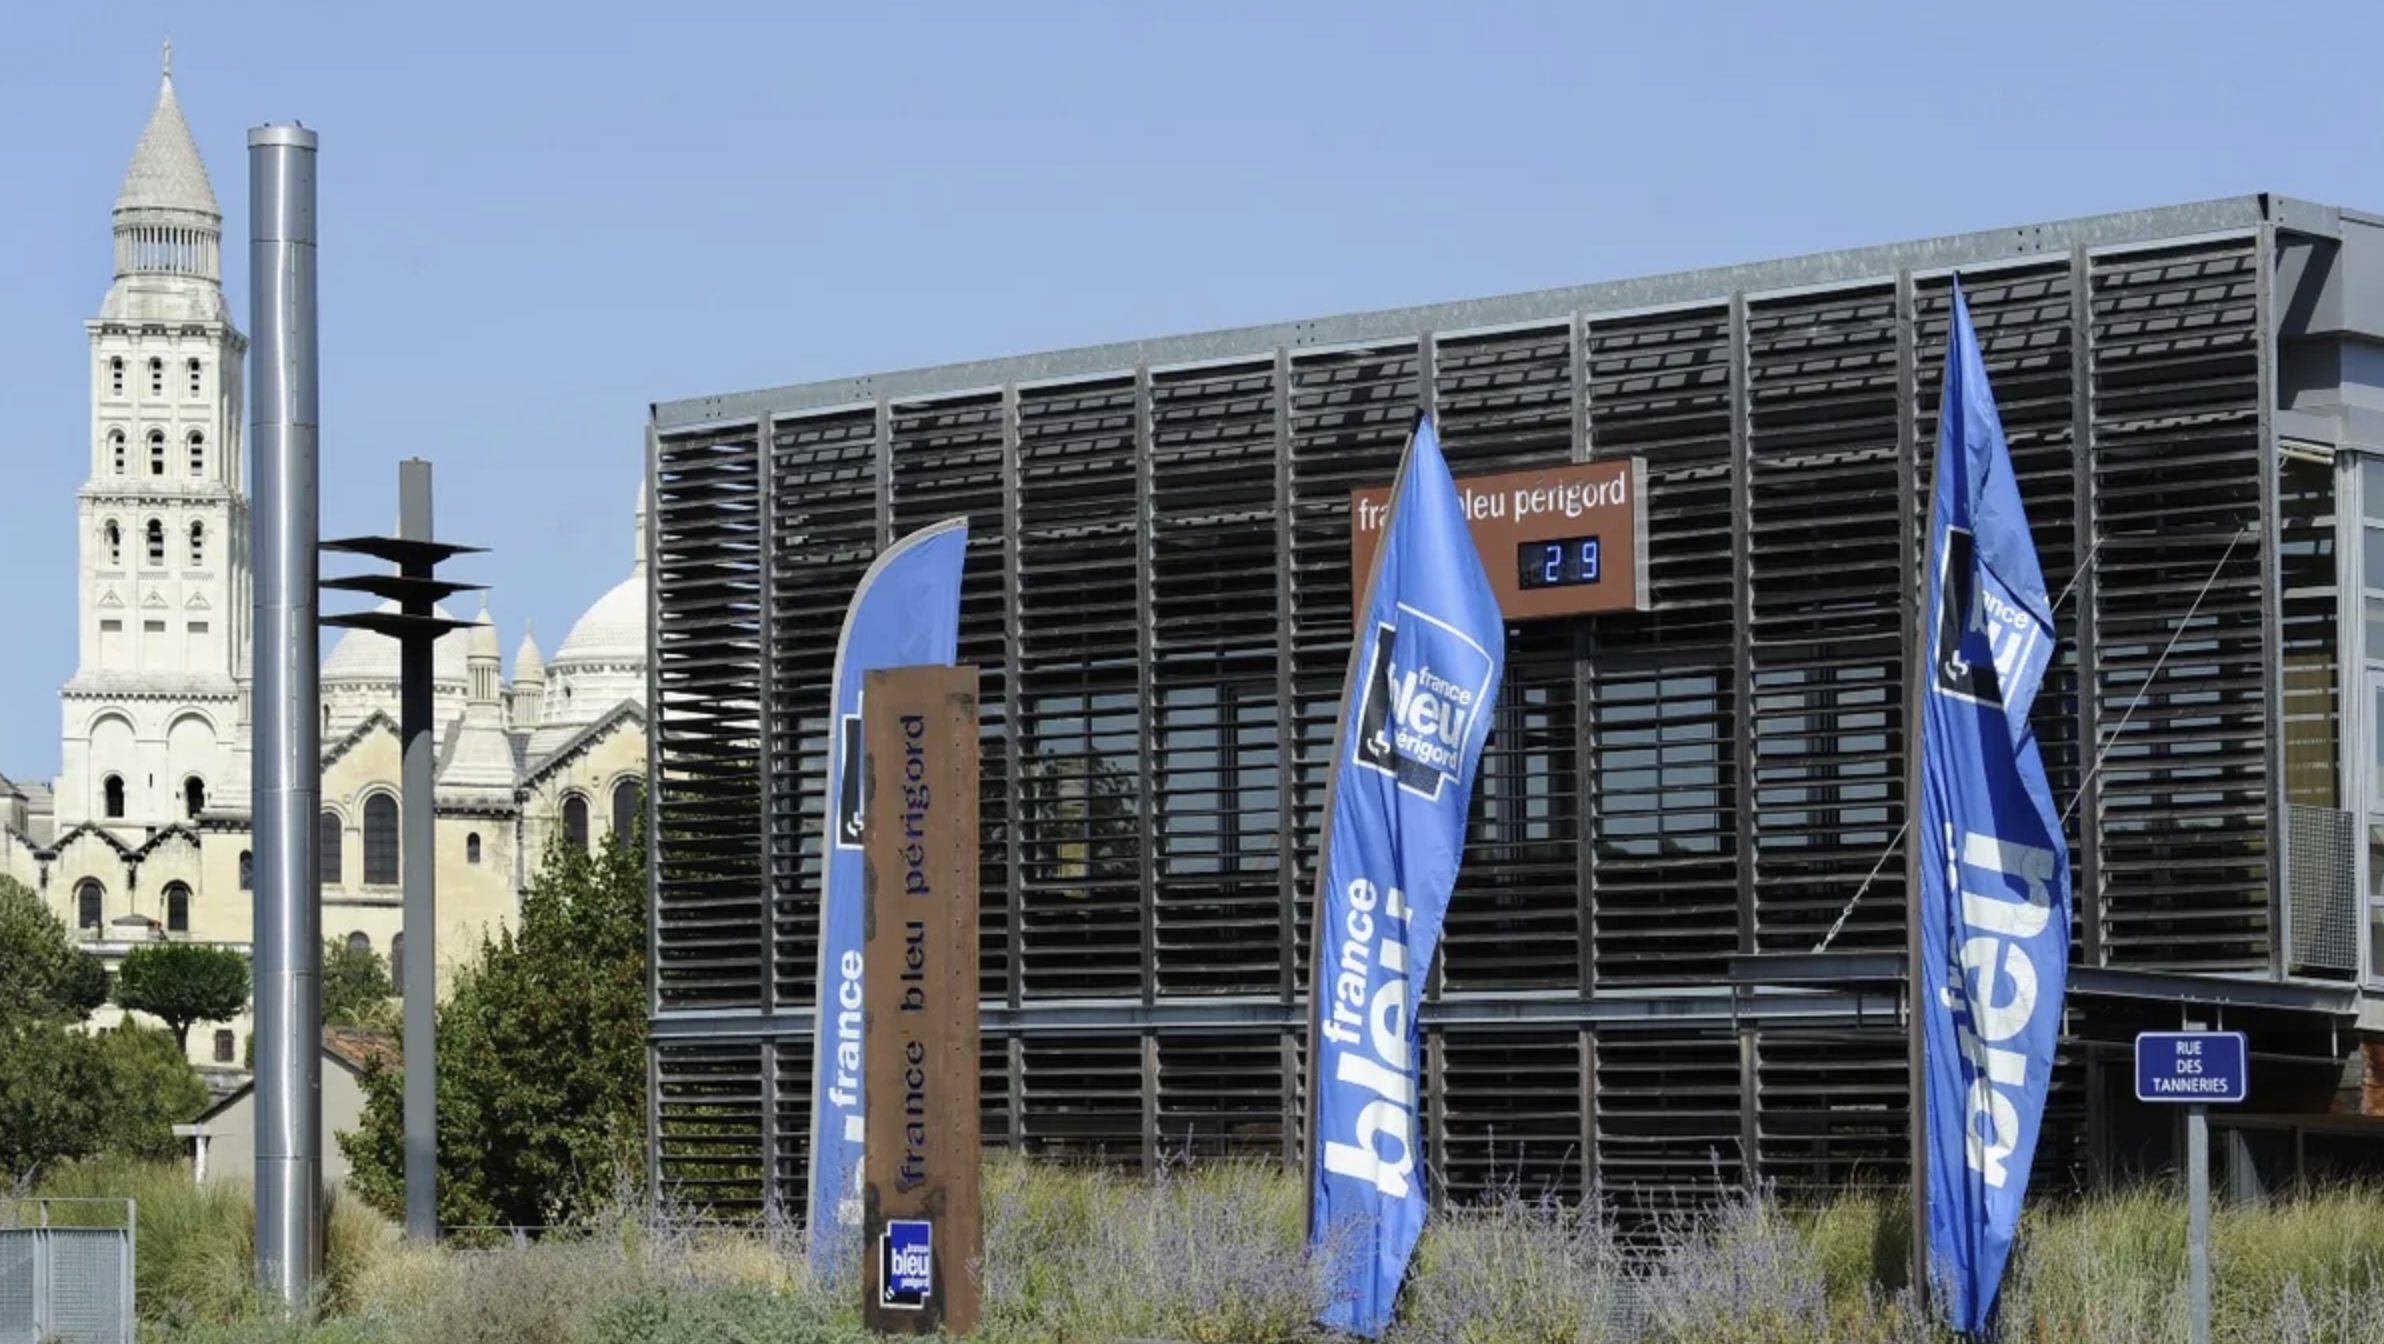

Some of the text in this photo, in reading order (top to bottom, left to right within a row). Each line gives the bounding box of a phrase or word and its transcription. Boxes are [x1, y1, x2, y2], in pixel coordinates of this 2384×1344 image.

[1459, 488, 1505, 521] leu
[1514, 471, 1626, 523] périgord
[1419, 665, 1471, 705] france
[1395, 726, 1458, 771] érigord
[900, 714, 931, 1181] france bleu périgord
[1322, 877, 1378, 1045] france
[828, 949, 864, 1107] france
[2176, 1041, 2203, 1055] RUE
[2152, 1077, 2229, 1093] TANNERIES
[2176, 1059, 2203, 1074] DES
[891, 1248, 929, 1276] bleu
